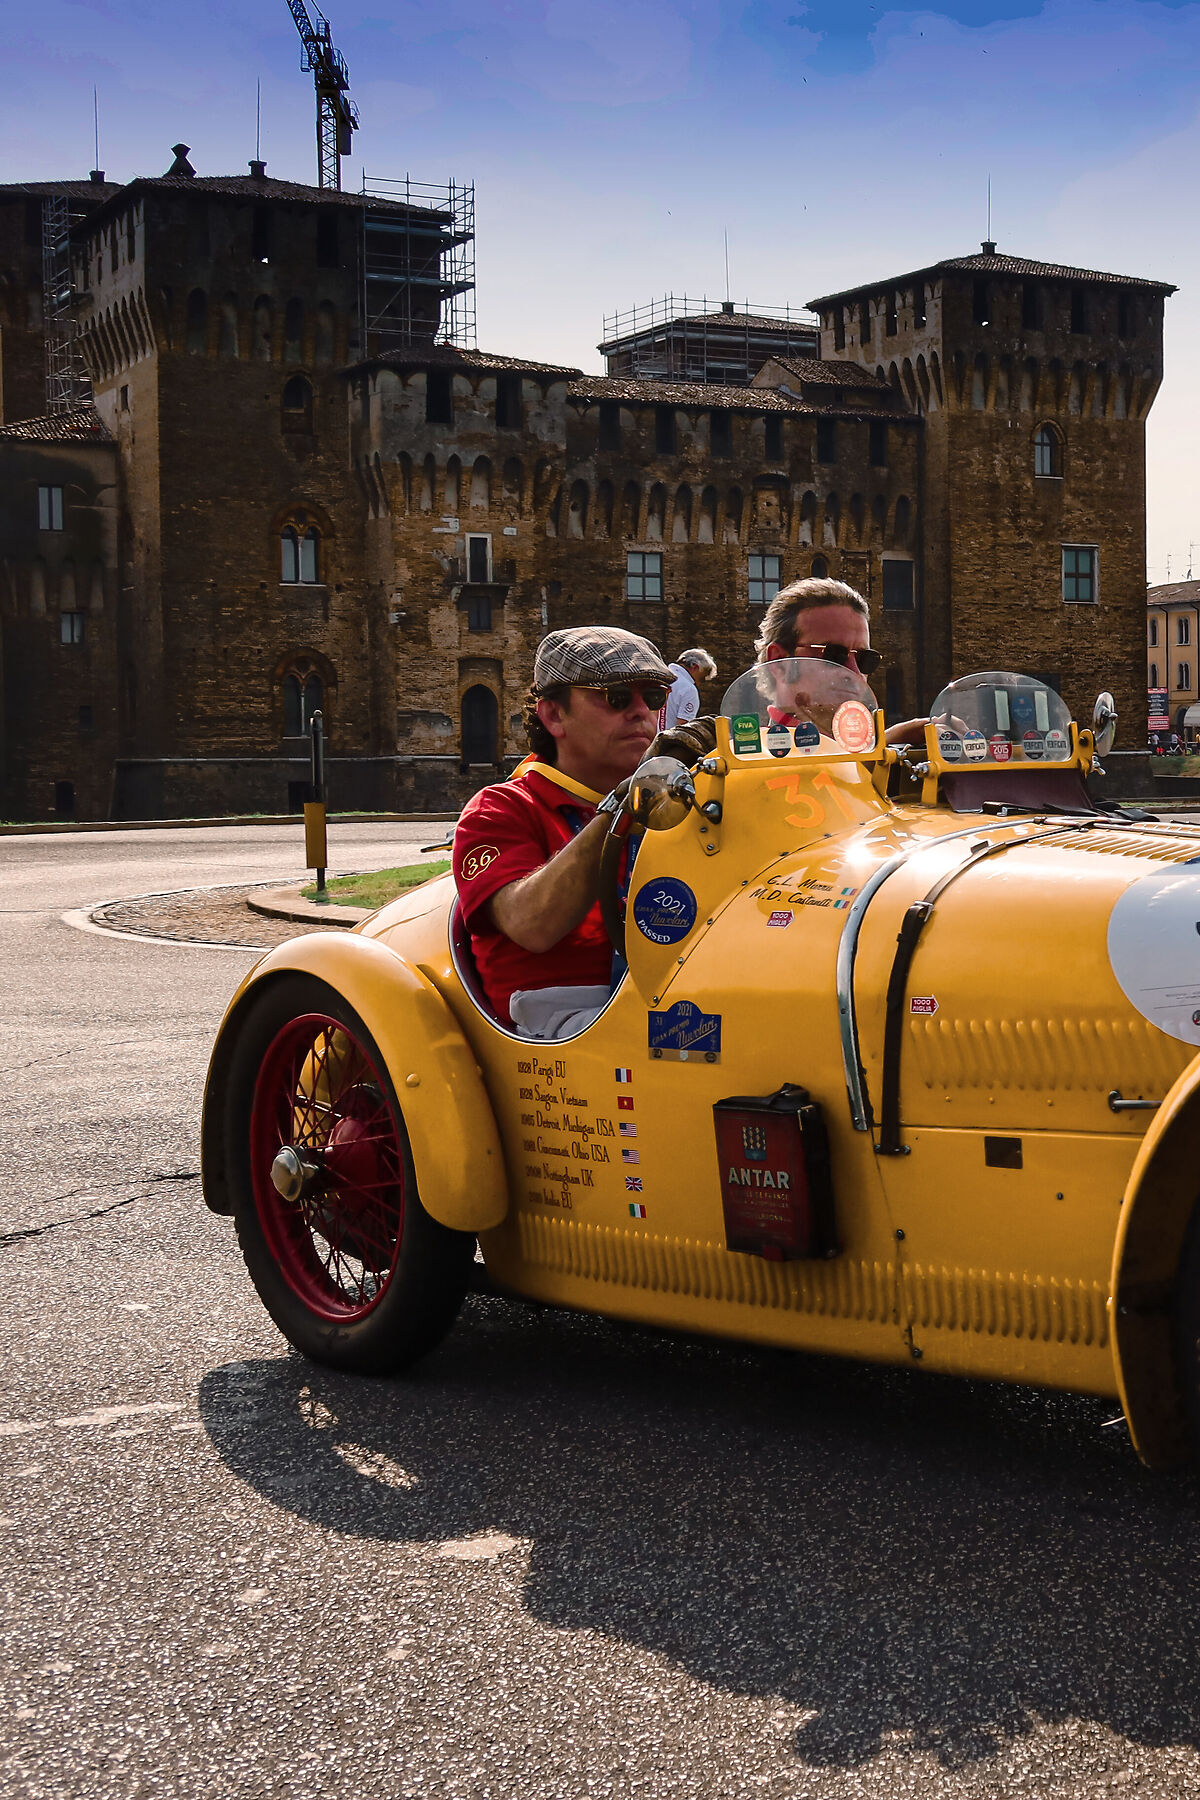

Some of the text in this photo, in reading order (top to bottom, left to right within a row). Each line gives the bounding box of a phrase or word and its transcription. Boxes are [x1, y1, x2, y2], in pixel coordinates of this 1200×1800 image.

[765, 770, 856, 829] 31
[467, 849, 492, 876] 36
[652, 890, 686, 916] 2021
[748, 888, 781, 902] M.D.
[637, 919, 671, 943] PASSED
[676, 1002, 693, 1017] 2021
[532, 1057, 554, 1086] Parigi
[555, 1060, 566, 1078] EU
[559, 1087, 588, 1107] Vietnam
[562, 1114, 595, 1142] Michigan
[596, 1117, 616, 1137] USA
[571, 1141, 590, 1160] Ohio
[590, 1143, 611, 1163] USA
[581, 1168, 594, 1187] UK
[728, 1167, 790, 1190] ANTAR
[561, 1191, 573, 1210] EU
